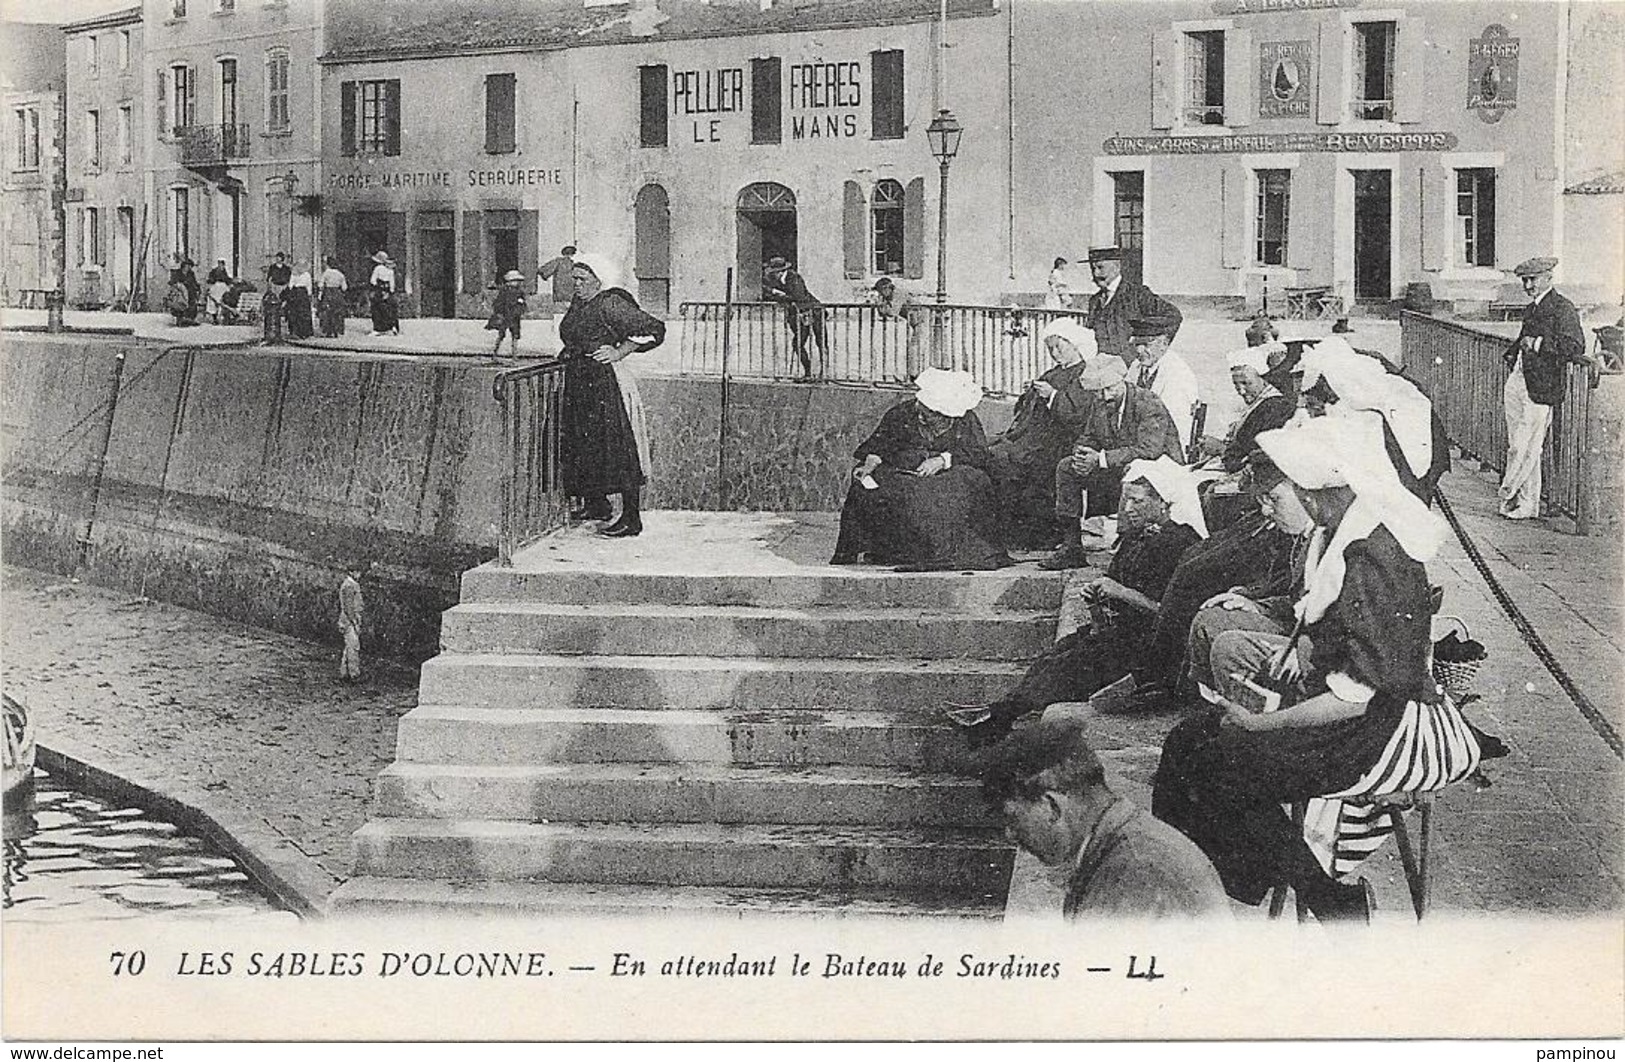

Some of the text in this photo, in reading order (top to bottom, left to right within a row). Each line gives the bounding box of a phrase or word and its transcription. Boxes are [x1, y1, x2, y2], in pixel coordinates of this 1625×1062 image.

[674, 57, 861, 116] PELLIER FRÈRES
[693, 114, 857, 143] LE MANS
[1109, 137, 1145, 151] VINS
[1160, 137, 1199, 151] GROS
[1326, 133, 1447, 151] BUVETTE
[331, 173, 371, 189] FORGE
[382, 172, 450, 188] MARITIME
